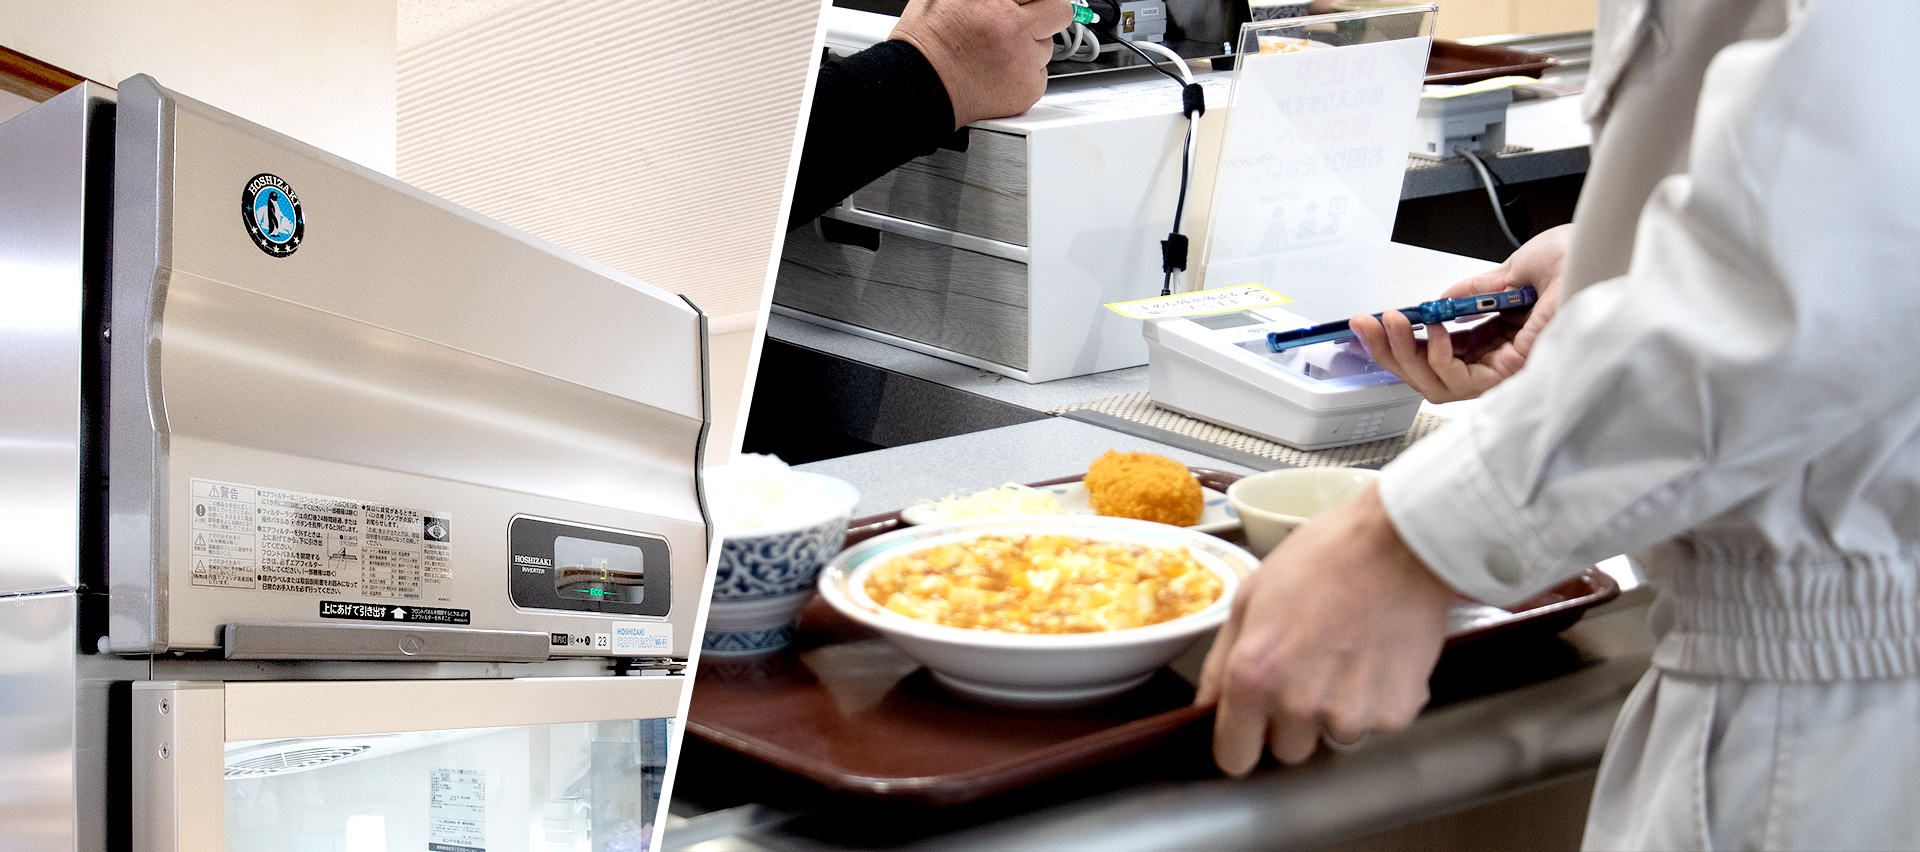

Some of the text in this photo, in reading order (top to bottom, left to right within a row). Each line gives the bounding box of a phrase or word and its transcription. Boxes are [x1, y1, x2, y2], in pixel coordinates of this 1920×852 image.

[247, 175, 301, 207] HOSHIZAKI
[220, 486, 239, 500] 警告
[514, 554, 552, 567] HOSHIZAKI
[522, 566, 546, 575] INVERTER
[589, 587, 603, 597] ECO
[322, 602, 387, 618] 上にあげて引き出す
[616, 628, 645, 636] HOSHIZAKI
[598, 636, 607, 647] 23
